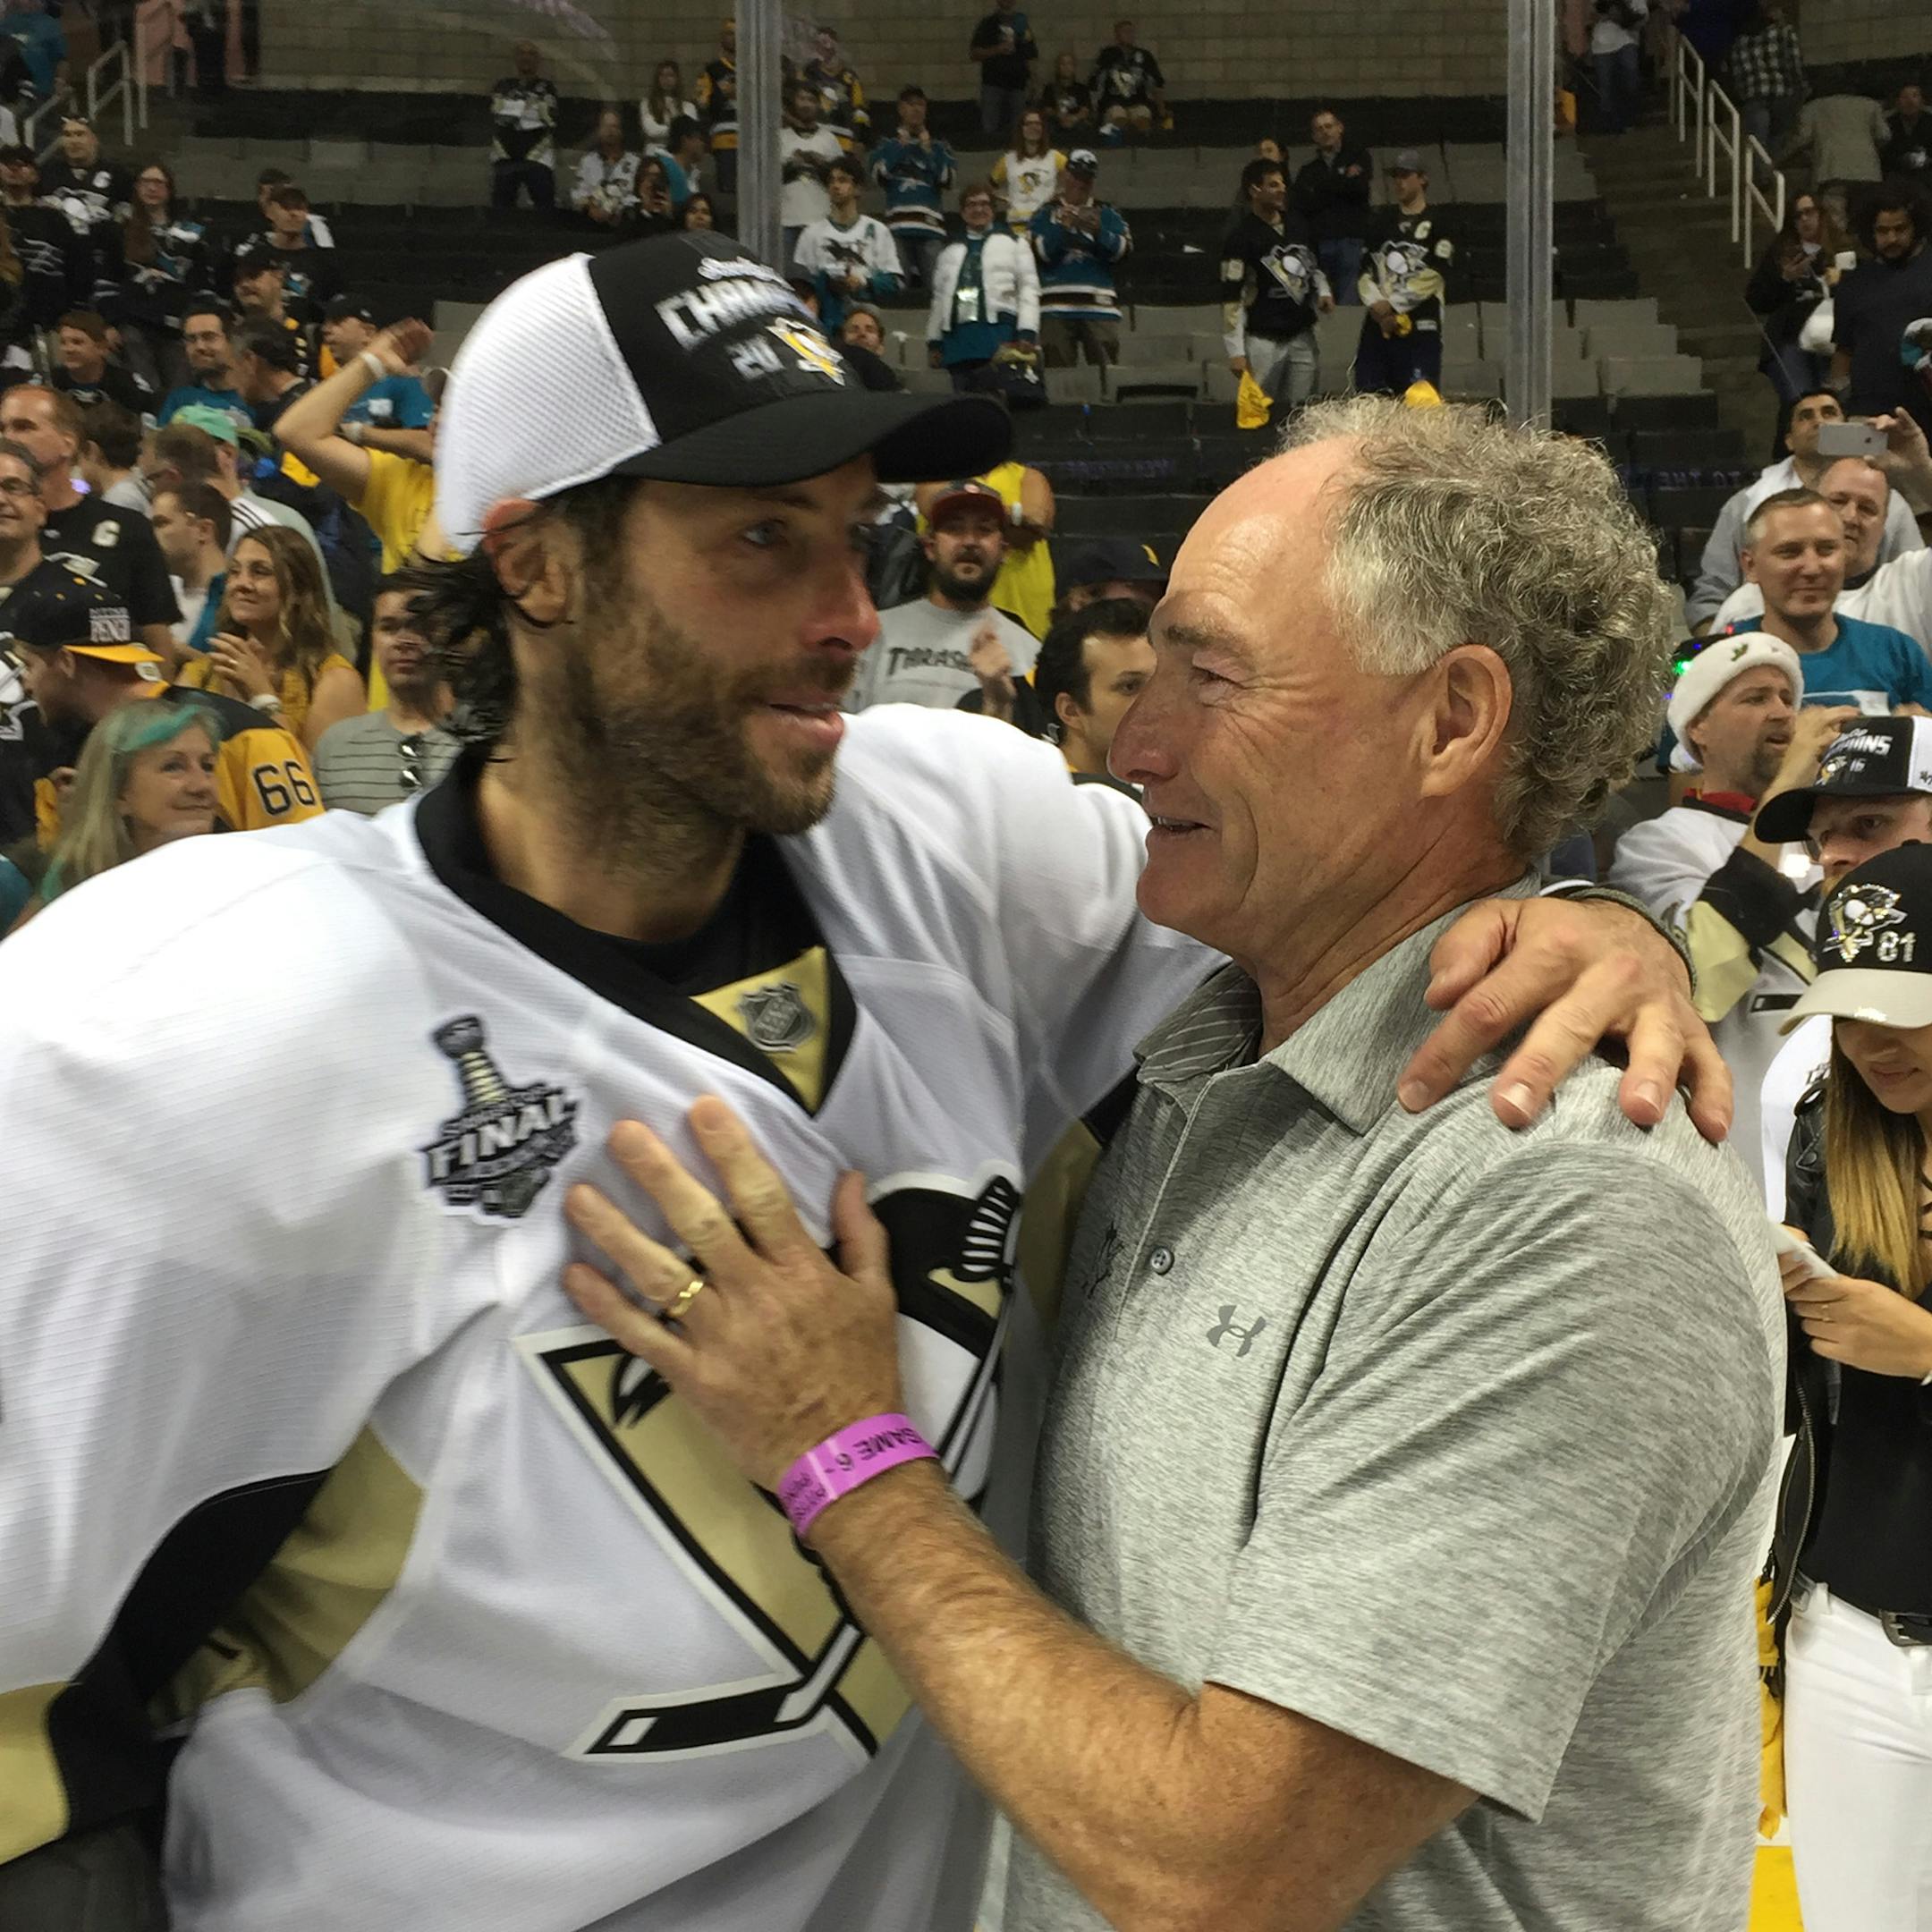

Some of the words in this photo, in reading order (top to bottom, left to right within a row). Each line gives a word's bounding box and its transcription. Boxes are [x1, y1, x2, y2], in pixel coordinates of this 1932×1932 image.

[253, 760, 317, 816] 66
[1876, 930, 1917, 963] 81
[428, 1093, 567, 1180] FINAL
